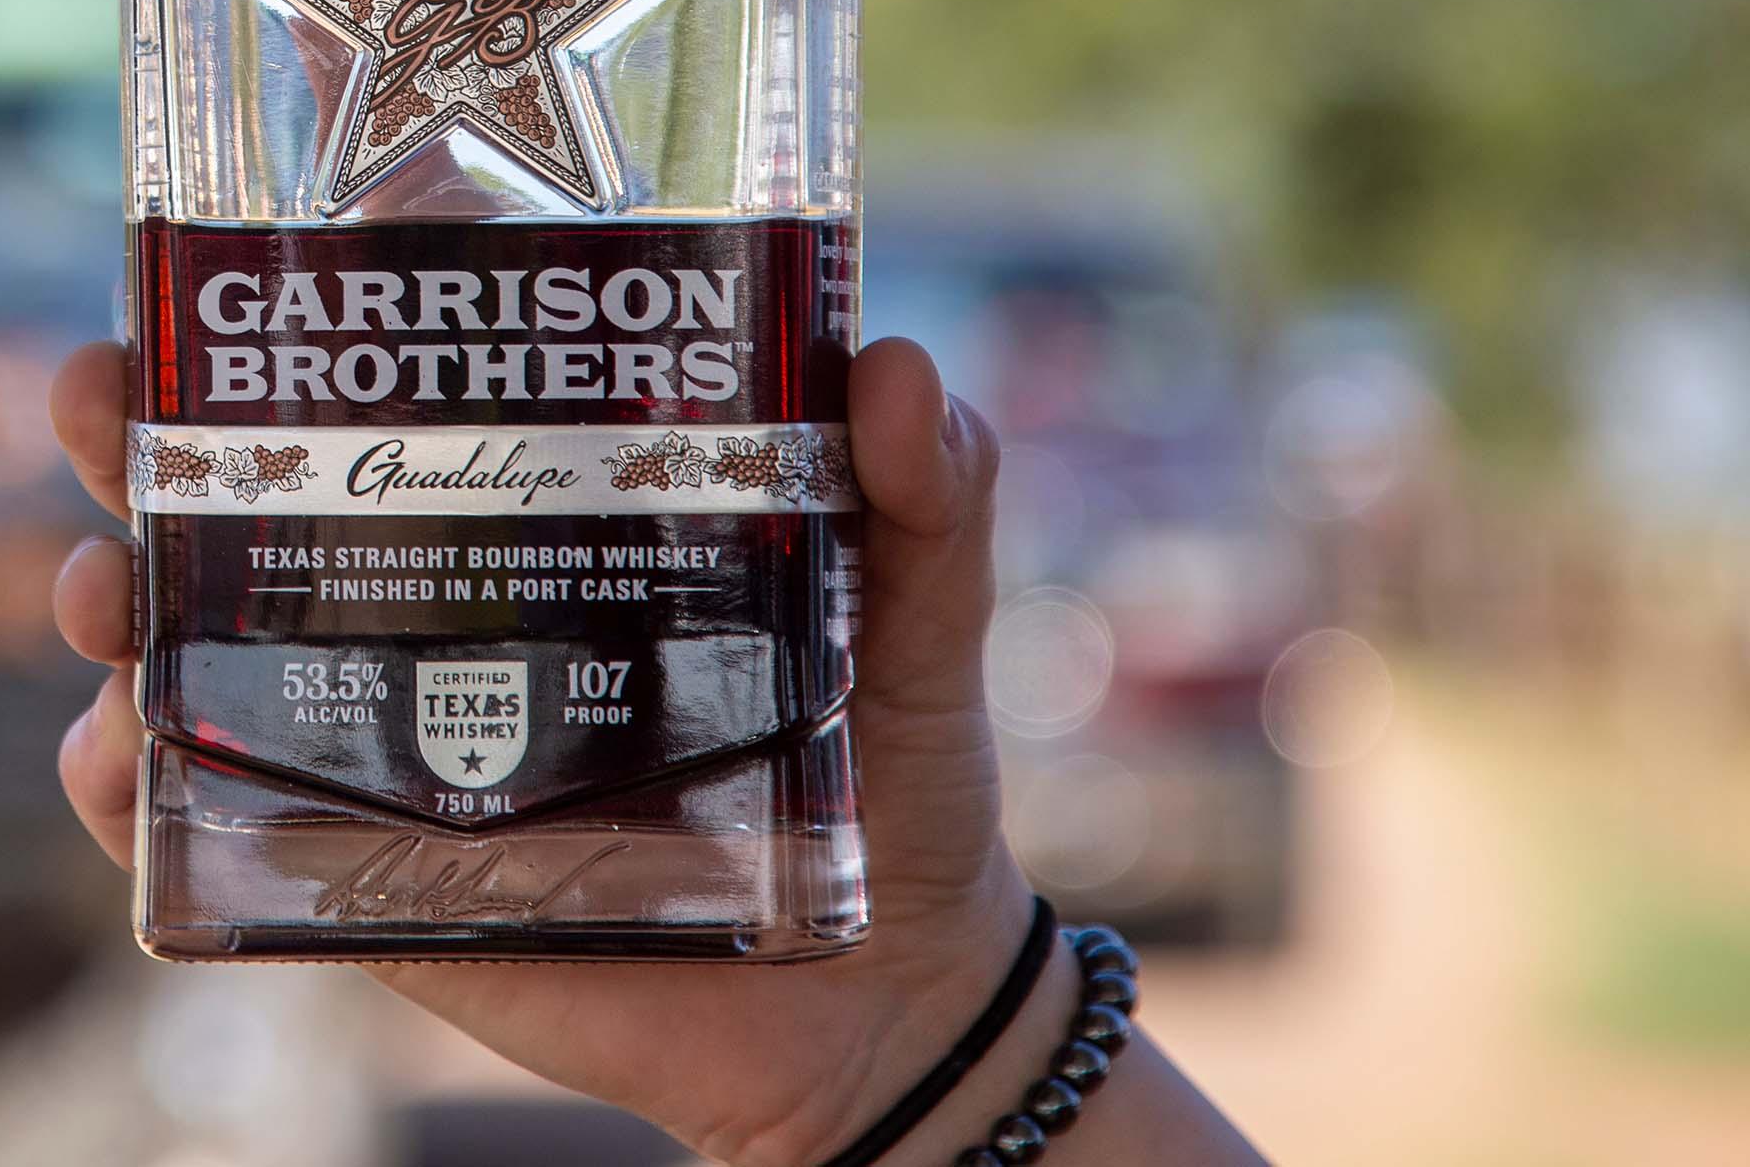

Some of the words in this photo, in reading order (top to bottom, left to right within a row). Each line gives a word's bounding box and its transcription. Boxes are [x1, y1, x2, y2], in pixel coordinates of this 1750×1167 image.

[197, 268, 743, 333] GARRISON
[205, 342, 738, 402] BROTHERS
[347, 439, 582, 507] Guadalupe
[248, 547, 326, 569] TEXAS
[335, 547, 459, 569] STRAIGHT
[467, 547, 594, 569] BOURBON
[602, 547, 721, 569] WHISKEY
[320, 579, 435, 601] FINISHED
[445, 579, 472, 601] IN
[481, 579, 498, 601] A
[507, 578, 572, 601] PORT
[580, 578, 649, 601] CASK
[282, 662, 389, 702] 53.5%
[433, 673, 511, 685] CERTIFIED
[567, 661, 632, 700] 107
[295, 706, 378, 724] ALC/VOL
[424, 694, 520, 718] TEXAS
[564, 706, 633, 725] PROOF
[424, 722, 518, 739] WHISKEY
[434, 793, 475, 814] 750
[483, 794, 516, 814] ML
